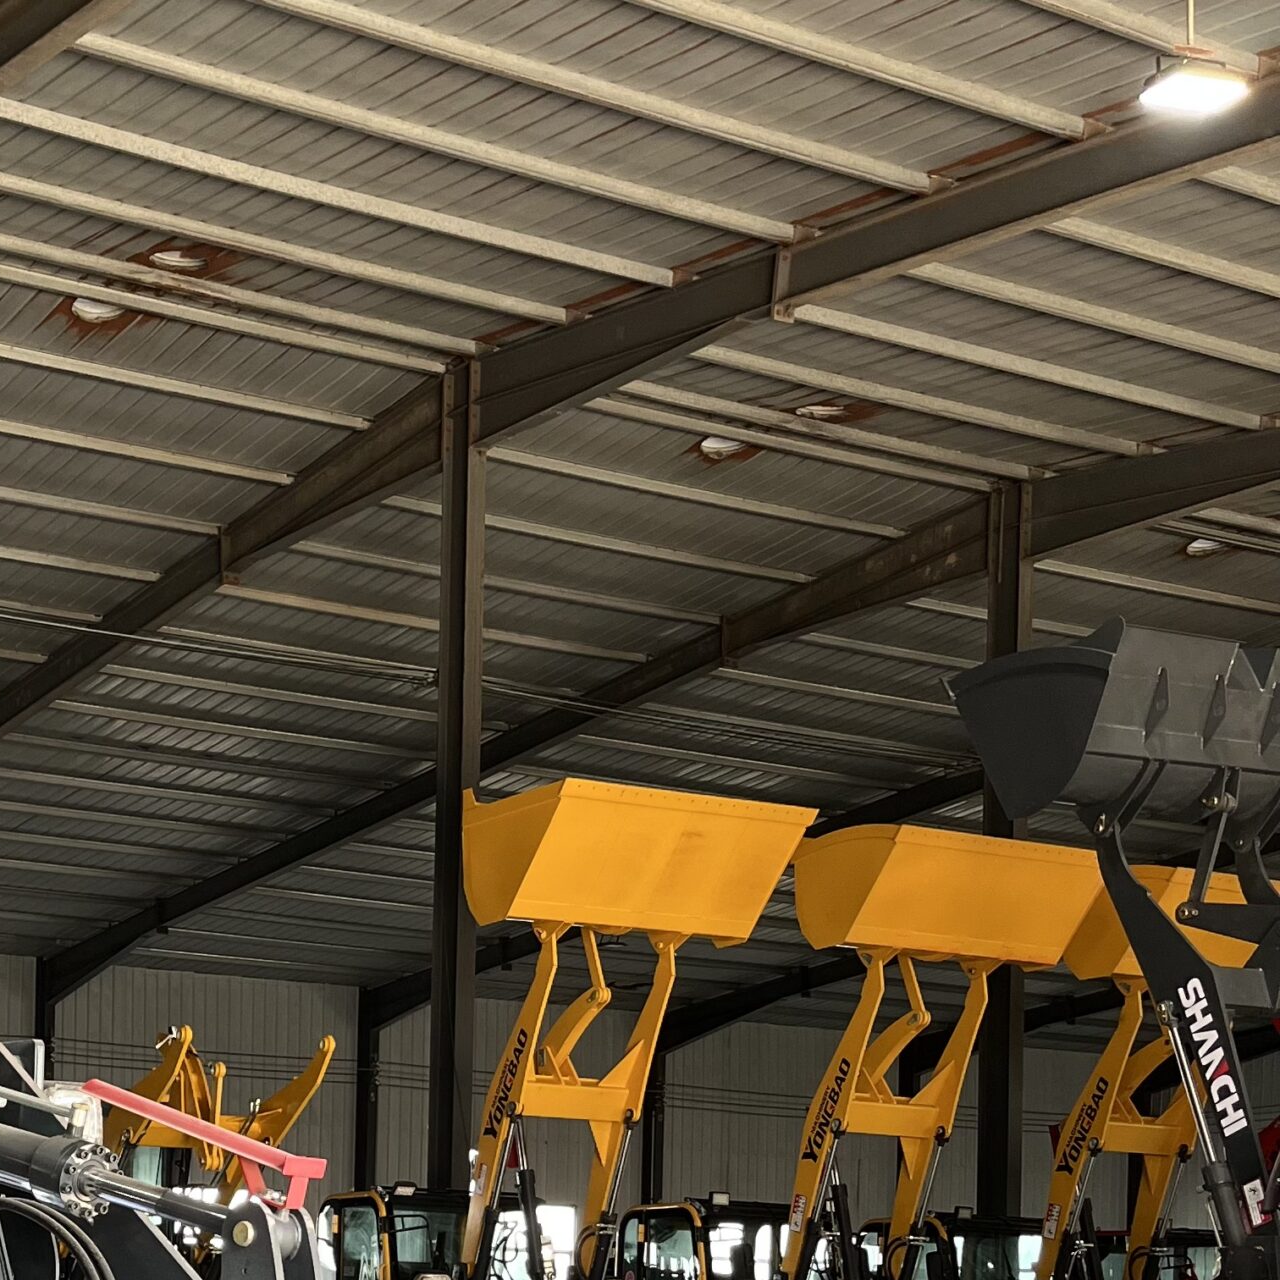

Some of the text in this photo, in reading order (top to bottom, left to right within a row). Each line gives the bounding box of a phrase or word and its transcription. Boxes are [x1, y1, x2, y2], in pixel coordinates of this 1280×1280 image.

[483, 1028, 528, 1139] YONGBAO
[801, 1057, 851, 1163] YONGBAO
[1177, 977, 1248, 1137] SHANCHI
[1055, 1076, 1109, 1176] YONGBAO
